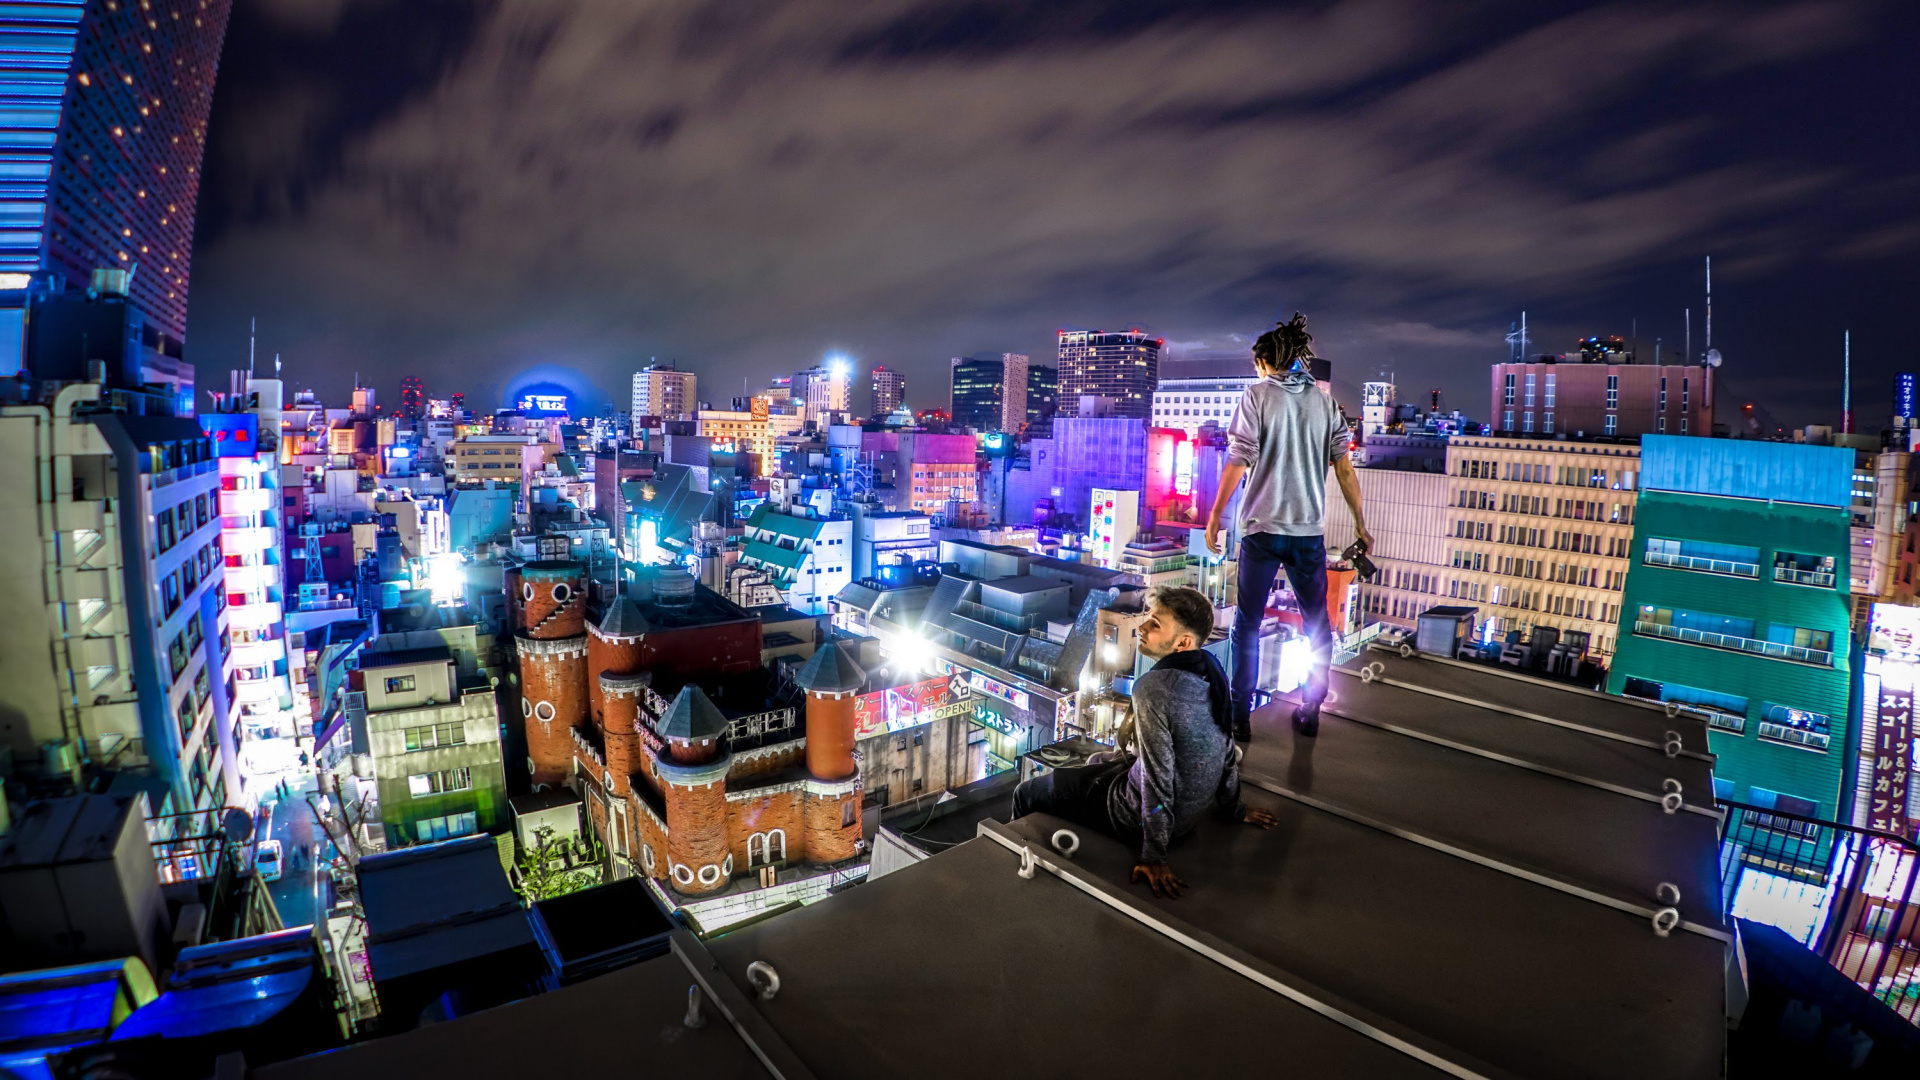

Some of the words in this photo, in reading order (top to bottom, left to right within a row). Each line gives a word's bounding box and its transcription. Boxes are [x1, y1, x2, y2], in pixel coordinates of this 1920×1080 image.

[1903, 387, 1911, 423] オザキク
[1038, 450, 1047, 466] P
[952, 678, 970, 697] 入口
[934, 701, 970, 719] OPEN!
[1873, 695, 1897, 831] スコールカフェ
[1890, 697, 1911, 832] スイーツ&ガレット
